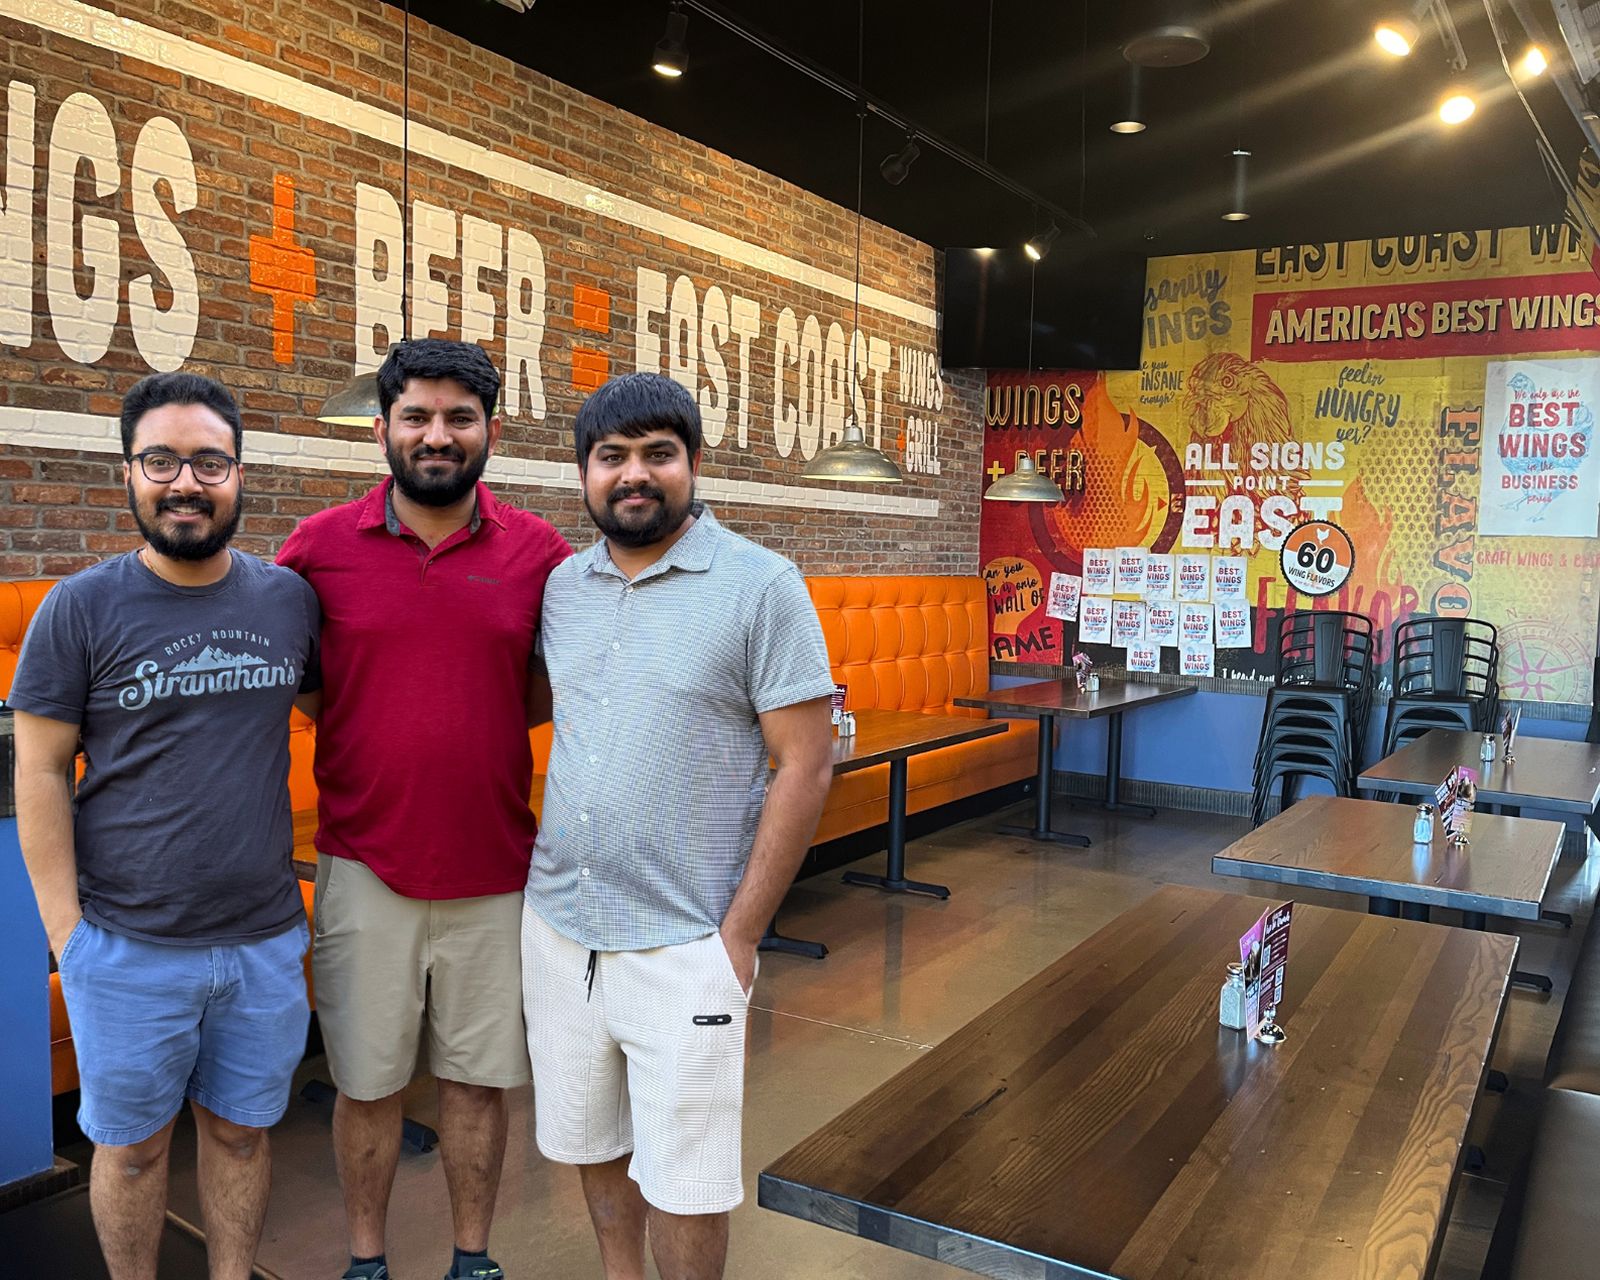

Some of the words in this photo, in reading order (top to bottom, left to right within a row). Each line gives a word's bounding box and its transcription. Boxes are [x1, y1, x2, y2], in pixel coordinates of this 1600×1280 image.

[355, 182, 547, 420] BEER
[636, 266, 760, 449] EAST
[773, 307, 891, 461] COAST
[1264, 301, 1427, 346] AMERICA'S
[1431, 297, 1503, 334] BEST
[1508, 292, 1600, 331] WINGS
[900, 345, 943, 411] WINGS
[1338, 362, 1386, 388] feelin
[985, 384, 1081, 426] WINGS
[1315, 386, 1400, 428] HUNGRY
[1509, 402, 1580, 427] BEST
[906, 415, 941, 475] GRILL
[1499, 432, 1587, 458] WINGS
[1185, 443, 1238, 470] ALL
[1250, 441, 1345, 470] SIGNS
[1233, 476, 1291, 490] POINT
[1501, 474, 1579, 489] BUSINESS
[1181, 495, 1343, 551] EAST
[1297, 542, 1335, 573] 60
[1476, 551, 1512, 566] CRAFT
[1517, 552, 1553, 567] WINGS
[1089, 559, 1109, 567] BEST
[1004, 562, 1025, 577] you
[1087, 567, 1111, 575] WINGS
[1119, 566, 1143, 574] WINGS
[1147, 564, 1168, 572] BEST
[1182, 565, 1203, 573] BEST
[1218, 567, 1240, 575] BEST
[1180, 573, 1205, 581] WINGS
[1215, 576, 1242, 584] WINGS
[1288, 566, 1306, 579] WING
[1307, 572, 1336, 587] FLAVORS
[994, 593, 1026, 615] WALL
[1031, 588, 1046, 607] OF
[1086, 607, 1106, 615] BEST
[1152, 609, 1173, 618] BEST
[1222, 610, 1243, 619] BEST
[1083, 615, 1107, 623] WINGS
[1119, 612, 1139, 620] BEST
[1186, 614, 1207, 622] BEST
[1116, 620, 1141, 628] WINGS
[1150, 617, 1175, 626] WINGS
[1220, 619, 1246, 627] WINGS
[1183, 622, 1209, 631] WINGS
[164, 632, 202, 656] ROCKY
[212, 629, 270, 648] MOUNTAIN
[990, 626, 1056, 660] AME
[1133, 650, 1154, 659] BEST
[1186, 654, 1208, 662] BEST
[1131, 658, 1156, 667] WINGS
[1184, 662, 1210, 671] WINGS
[118, 657, 296, 711] Stranahan's
